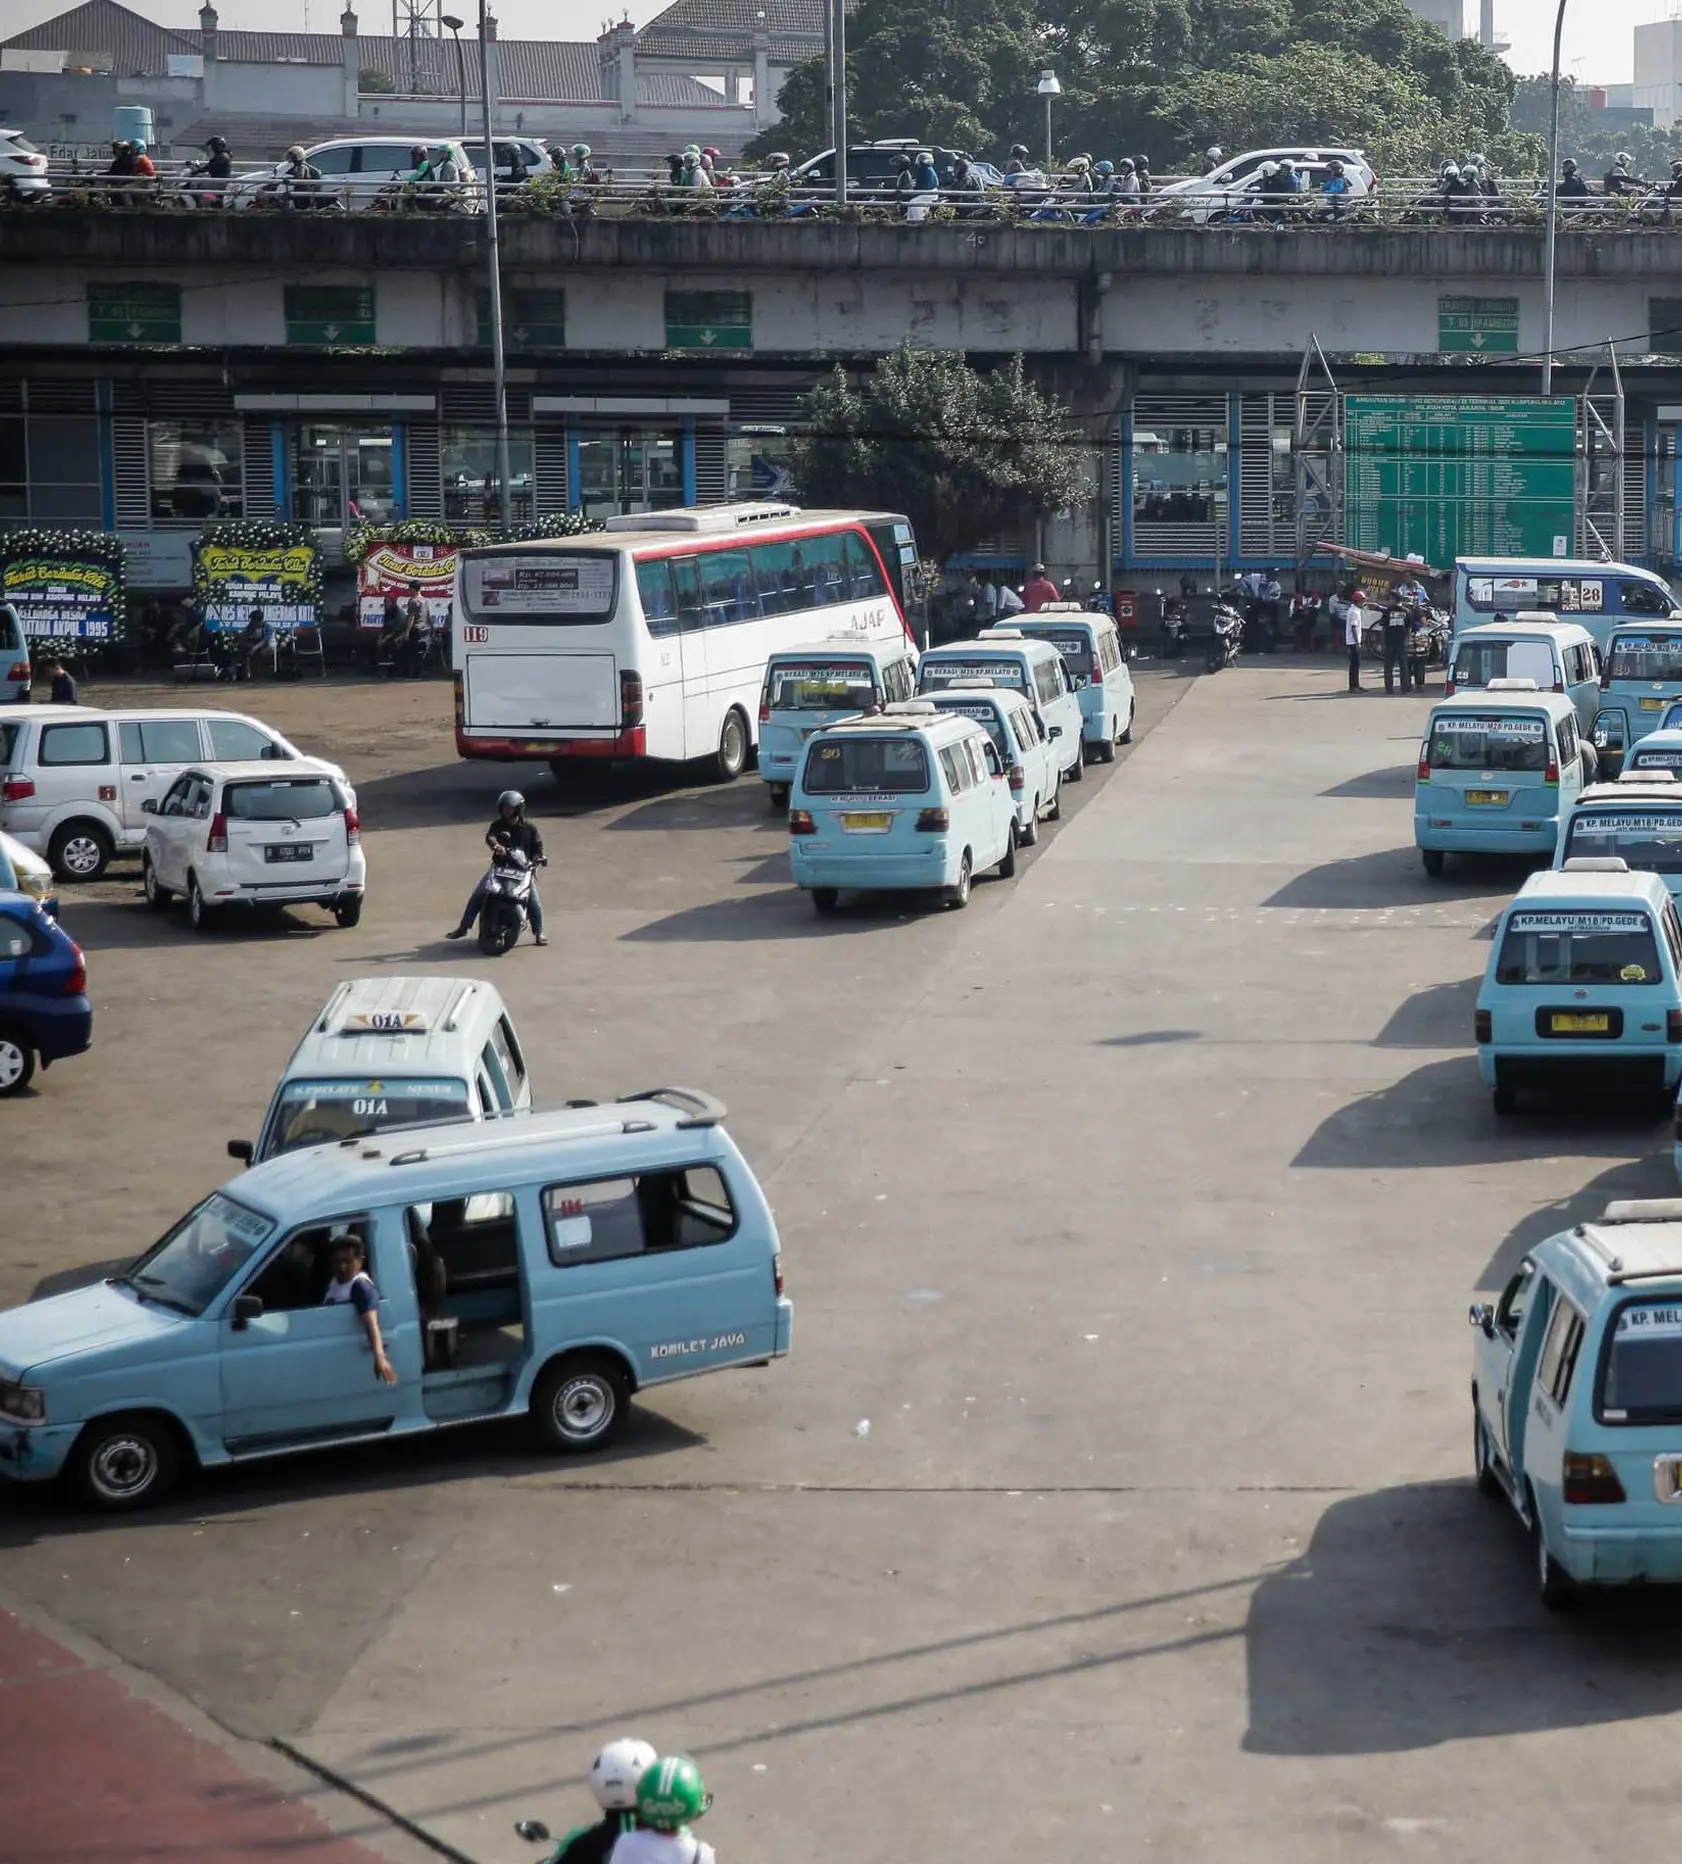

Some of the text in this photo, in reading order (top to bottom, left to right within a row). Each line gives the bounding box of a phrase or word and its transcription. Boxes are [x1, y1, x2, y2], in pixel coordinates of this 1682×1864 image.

[240, 556, 282, 573] Berduka
[405, 564, 447, 577] Berduka
[37, 566, 83, 581] Berduka
[86, 621, 108, 637] 1995
[464, 626, 488, 642] 119
[1599, 819, 1631, 828] MELAYU
[1602, 916, 1639, 927] PD.GEDE
[1632, 1310, 1650, 1325] KP.
[710, 1332, 745, 1351] JAYA
